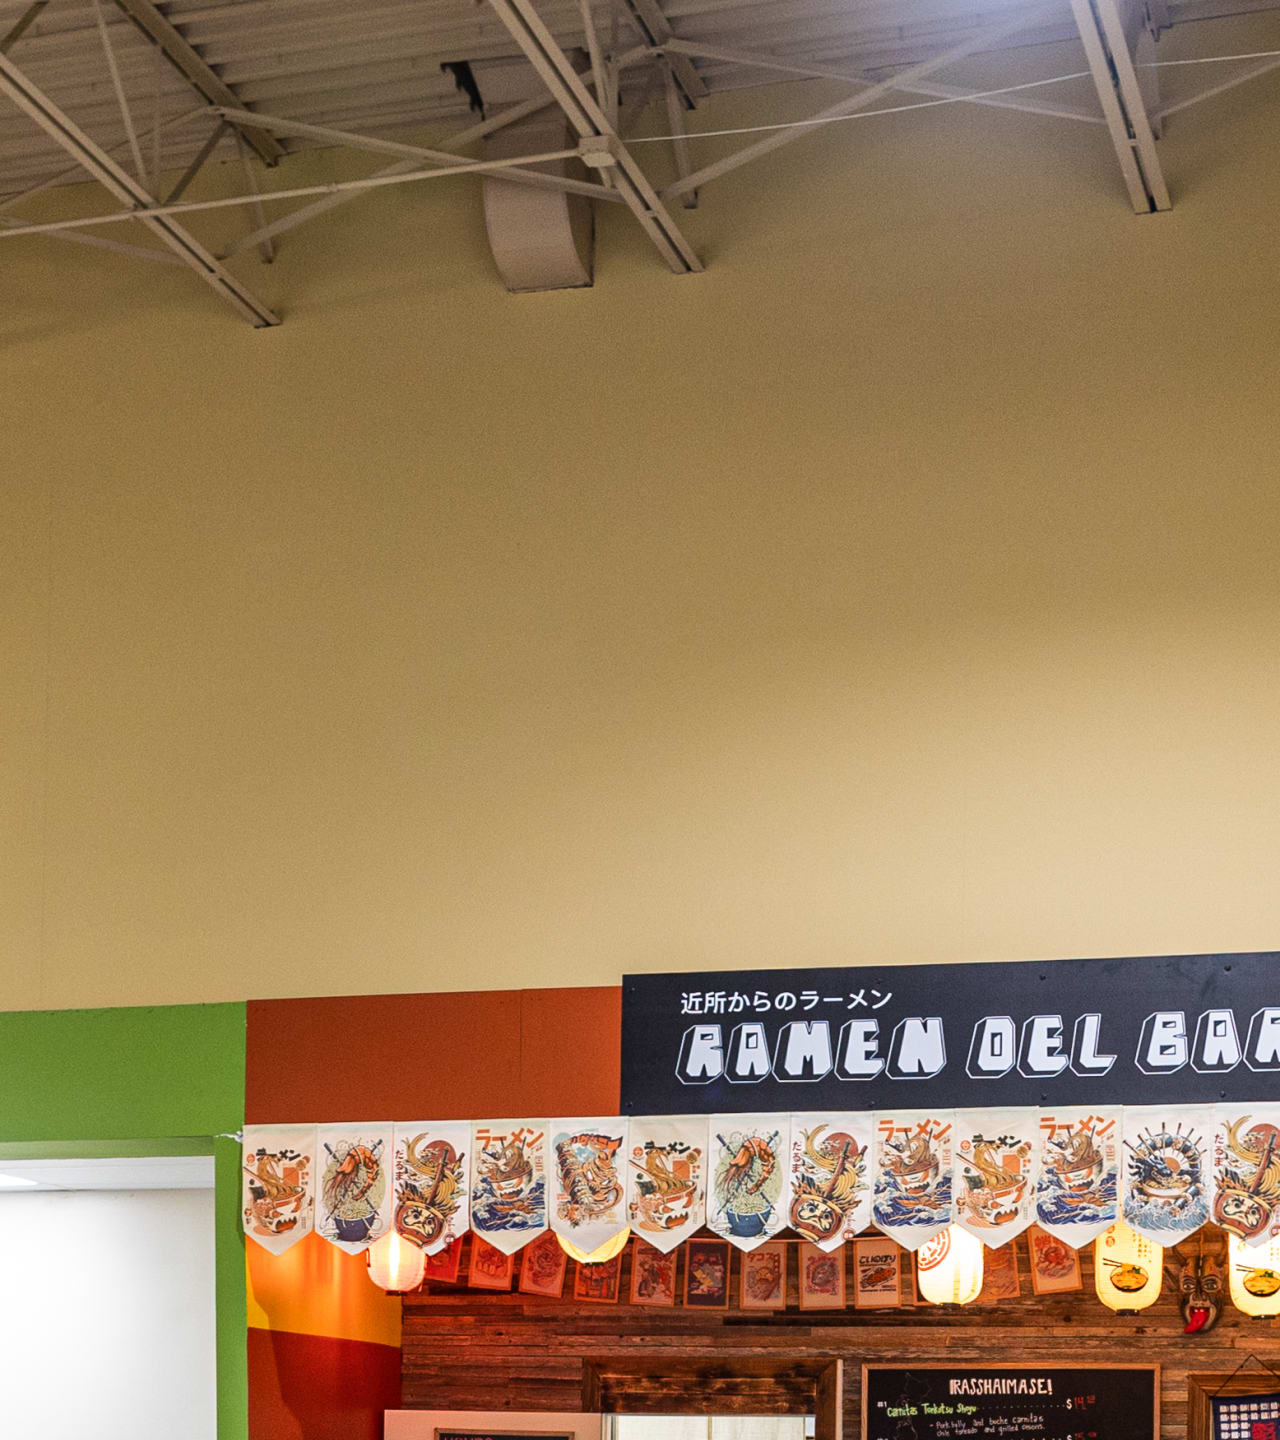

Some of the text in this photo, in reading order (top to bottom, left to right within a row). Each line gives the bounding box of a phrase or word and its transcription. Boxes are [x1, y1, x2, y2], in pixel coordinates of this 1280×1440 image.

[680, 989, 893, 1015] 近所からのラーメン
[675, 1016, 947, 1084] RAMEN
[965, 1012, 1117, 1078] DEL
